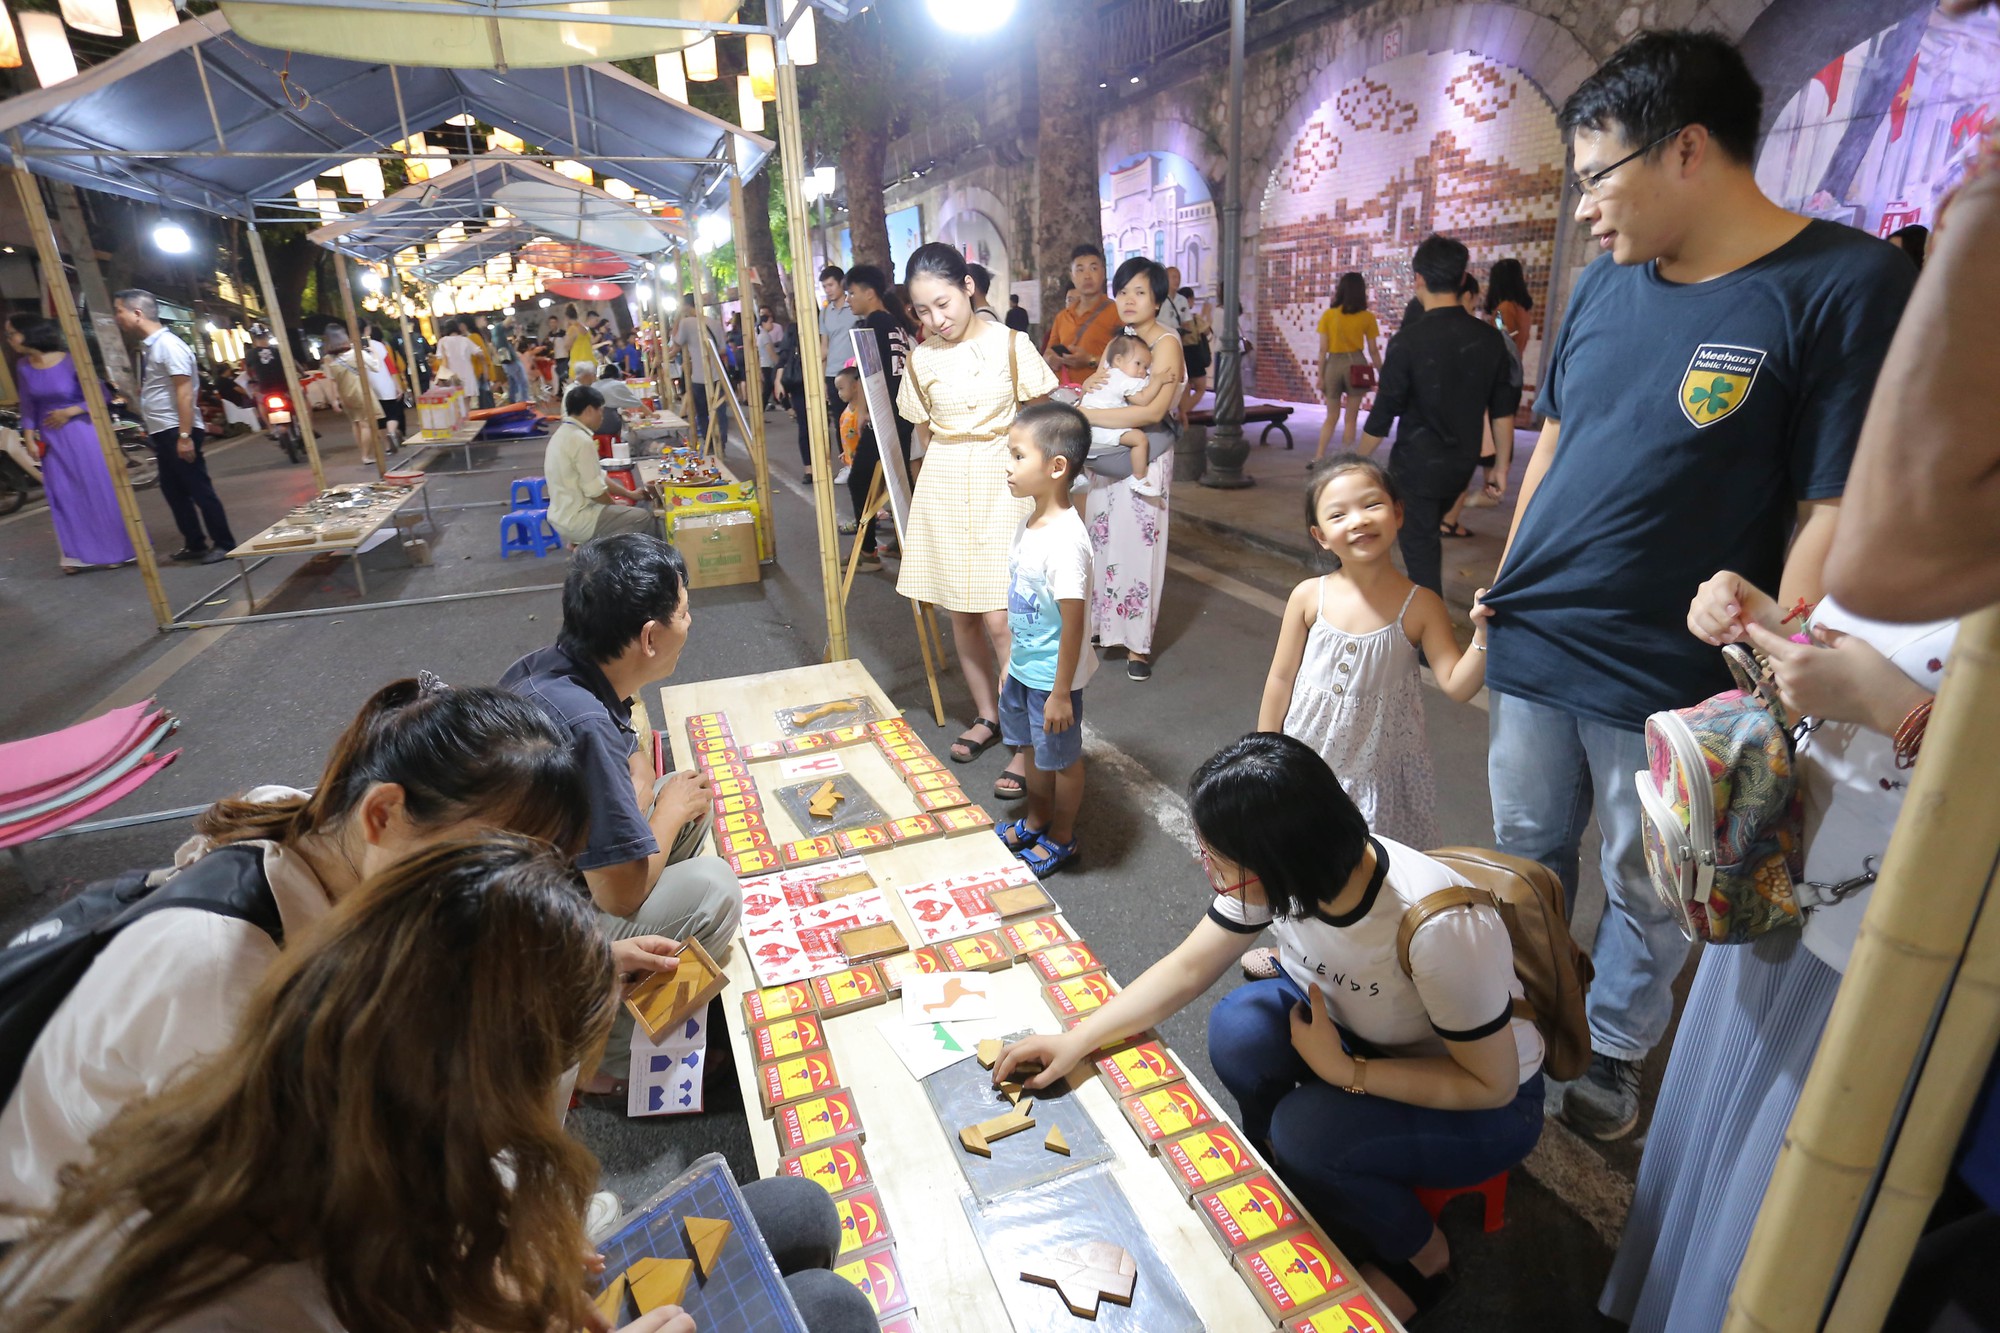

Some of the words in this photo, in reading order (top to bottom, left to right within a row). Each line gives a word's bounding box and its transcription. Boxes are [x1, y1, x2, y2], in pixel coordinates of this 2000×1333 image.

[1698, 350, 1757, 365] Meehan's
[1695, 360, 1721, 369] Public
[1723, 363, 1752, 373] House
